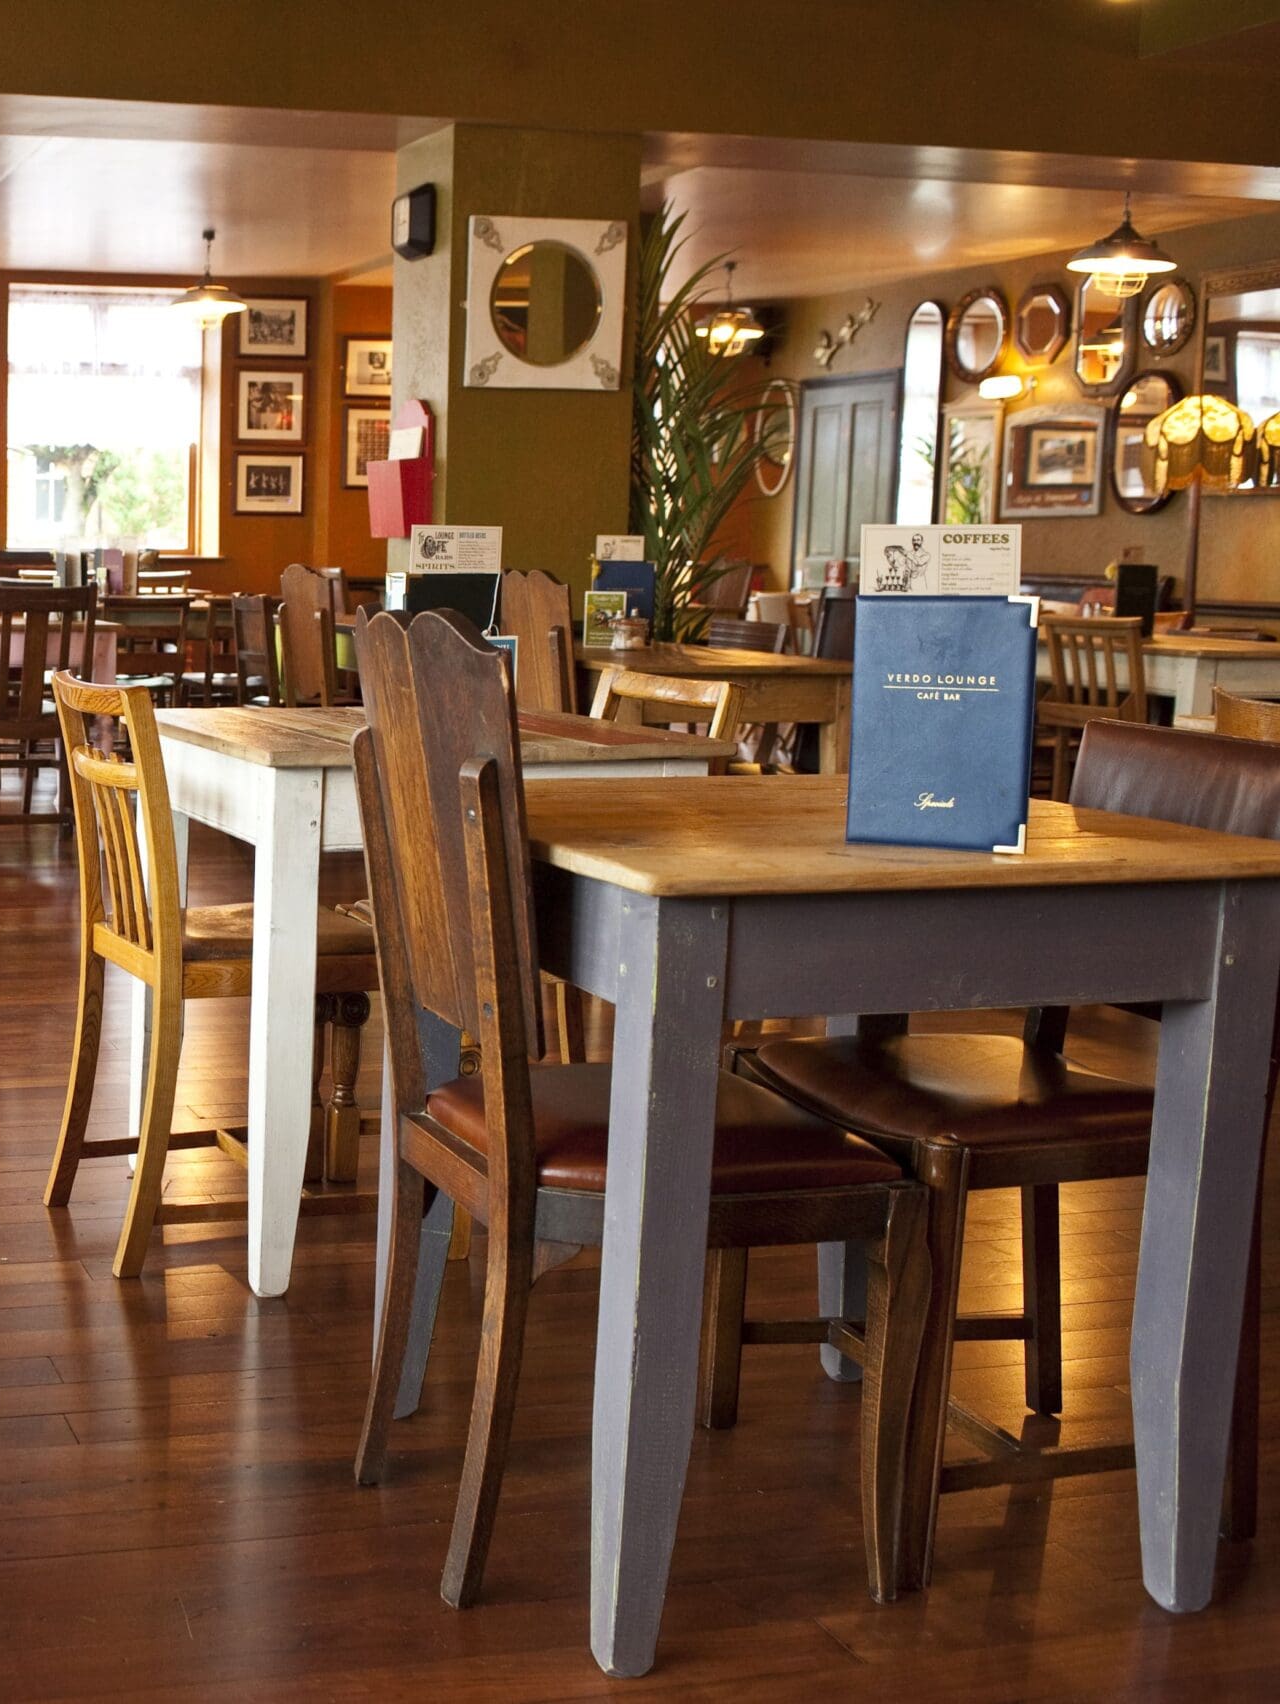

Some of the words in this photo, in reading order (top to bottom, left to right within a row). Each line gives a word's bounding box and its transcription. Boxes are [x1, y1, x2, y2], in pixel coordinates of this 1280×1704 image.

[435, 531, 455, 540] LOUNGE
[942, 533, 1010, 545] COFFEES
[415, 562, 455, 570] SPIRITS
[887, 673, 932, 684] VERDO
[937, 675, 996, 686] LOUNGE
[916, 691, 940, 701] CAFÉ
[943, 692, 961, 701] BAR
